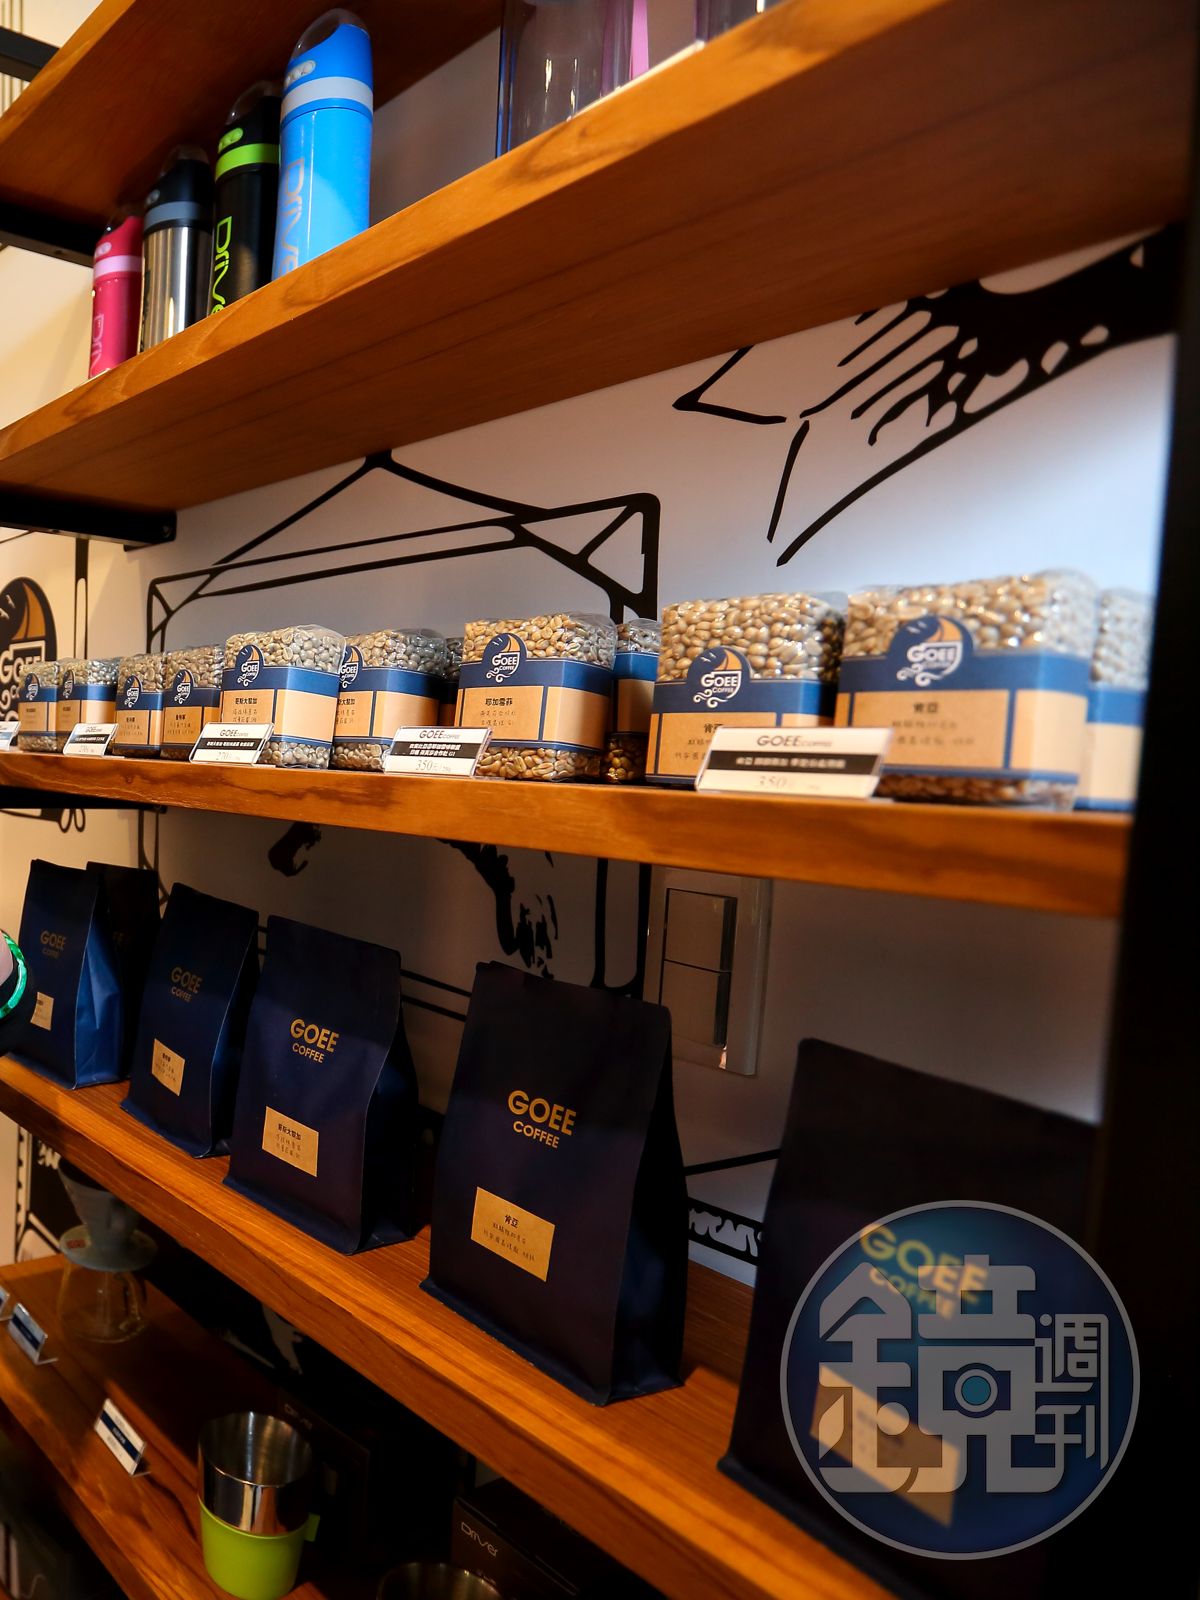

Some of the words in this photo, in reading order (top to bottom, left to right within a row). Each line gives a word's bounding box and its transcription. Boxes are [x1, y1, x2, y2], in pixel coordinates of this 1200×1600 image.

[241, 663, 258, 672] GOEE
[492, 655, 517, 666] GOEE
[340, 664, 357, 674] GOEE
[701, 673, 738, 687] GOEE
[419, 730, 445, 739] GOEE
[757, 735, 801, 747] GOEE
[170, 966, 203, 994] GOEE
[290, 1018, 339, 1053] GOEE
[292, 1042, 326, 1064] COFFEE
[507, 1090, 577, 1136] GOEE
[513, 1120, 560, 1149] COFFEE
[504, 1213, 520, 1229] 肯亞
